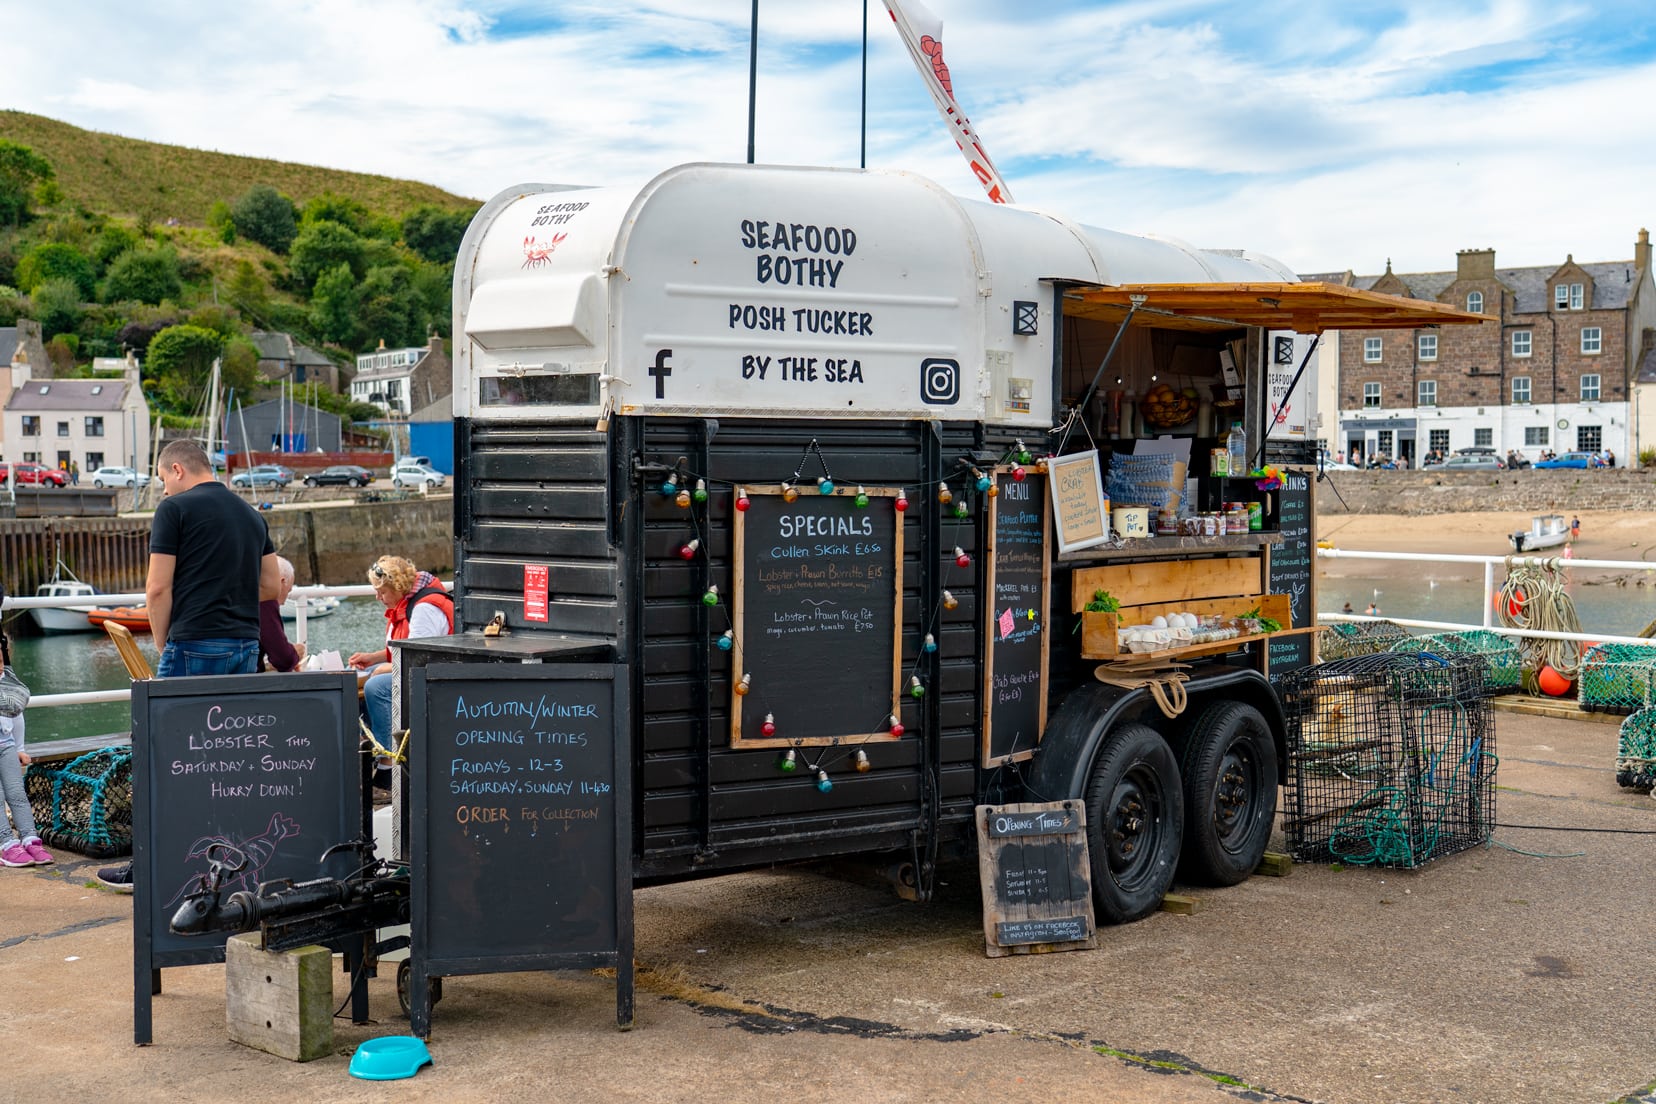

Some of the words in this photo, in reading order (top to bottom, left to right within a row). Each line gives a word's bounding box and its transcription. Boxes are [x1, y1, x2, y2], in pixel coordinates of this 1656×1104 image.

[537, 202, 590, 215] SEAFOOD
[531, 213, 575, 227] BOTHY
[741, 219, 857, 256] SEAFOOD
[757, 255, 844, 288] BOTHY
[729, 304, 786, 331] POSH
[792, 309, 873, 336] TUCKER
[742, 355, 771, 380] BY
[778, 356, 818, 382] THE
[825, 358, 864, 384] SEA
[1005, 483, 1029, 500] MENU
[779, 515, 873, 537] SPECIALS
[771, 546, 809, 558] Cullen
[759, 568, 793, 582] Lobster
[801, 564, 826, 579] Prawn
[775, 612, 806, 622] Lobster
[815, 608, 839, 620] Prawn
[841, 610, 858, 620] Rice
[861, 608, 873, 620] Pot
[1270, 644, 1295, 653] FACEBOOK
[1270, 654, 1299, 665] INSTAGRAM
[207, 705, 277, 732] COOKED
[189, 734, 274, 750] LOBSTER
[286, 736, 311, 748] THIS
[455, 730, 525, 746] OPENING
[535, 731, 588, 746] TIMES
[171, 759, 245, 775] SATURDAY
[261, 755, 316, 772] SUNDAY
[451, 758, 511, 776] FRIDAYS
[211, 782, 254, 798] HURRY
[450, 780, 519, 794] SATURDAY
[524, 780, 573, 795] SUNDAY
[456, 806, 510, 823] ORDER
[522, 808, 538, 820] FOR
[542, 808, 599, 820] COLLECTION
[996, 817, 1033, 833] OPENING
[1036, 813, 1062, 832] TIMES
[1004, 924, 1020, 932] LIKE
[1046, 921, 1079, 929] FACEBOOK
